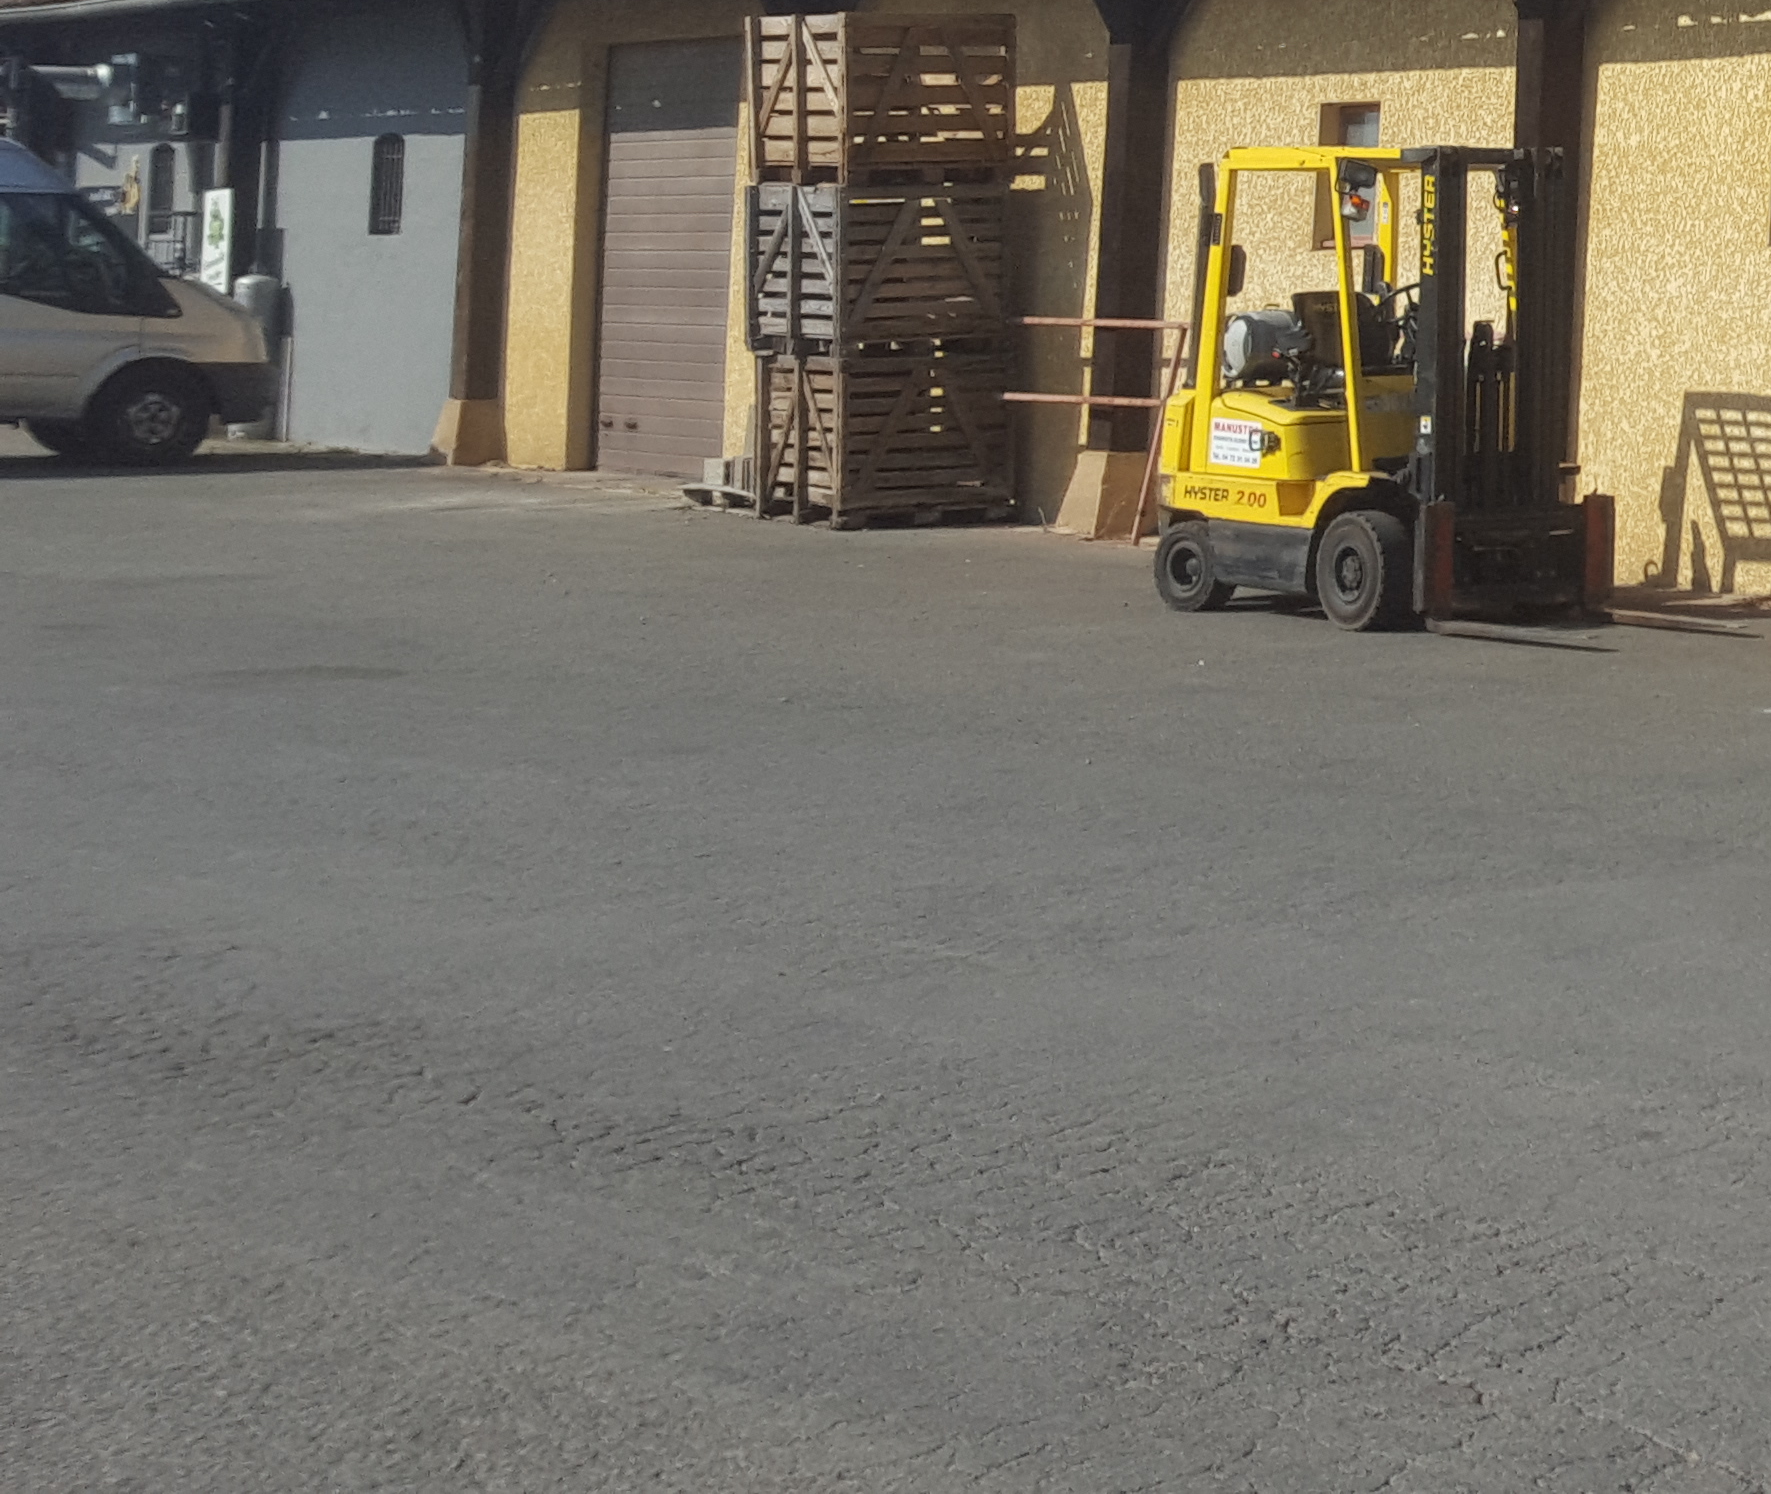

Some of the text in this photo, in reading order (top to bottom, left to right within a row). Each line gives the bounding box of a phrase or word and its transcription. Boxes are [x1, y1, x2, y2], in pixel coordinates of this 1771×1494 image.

[1422, 174, 1436, 277] HYSTER
[1183, 484, 1268, 508] HYSTER 200
